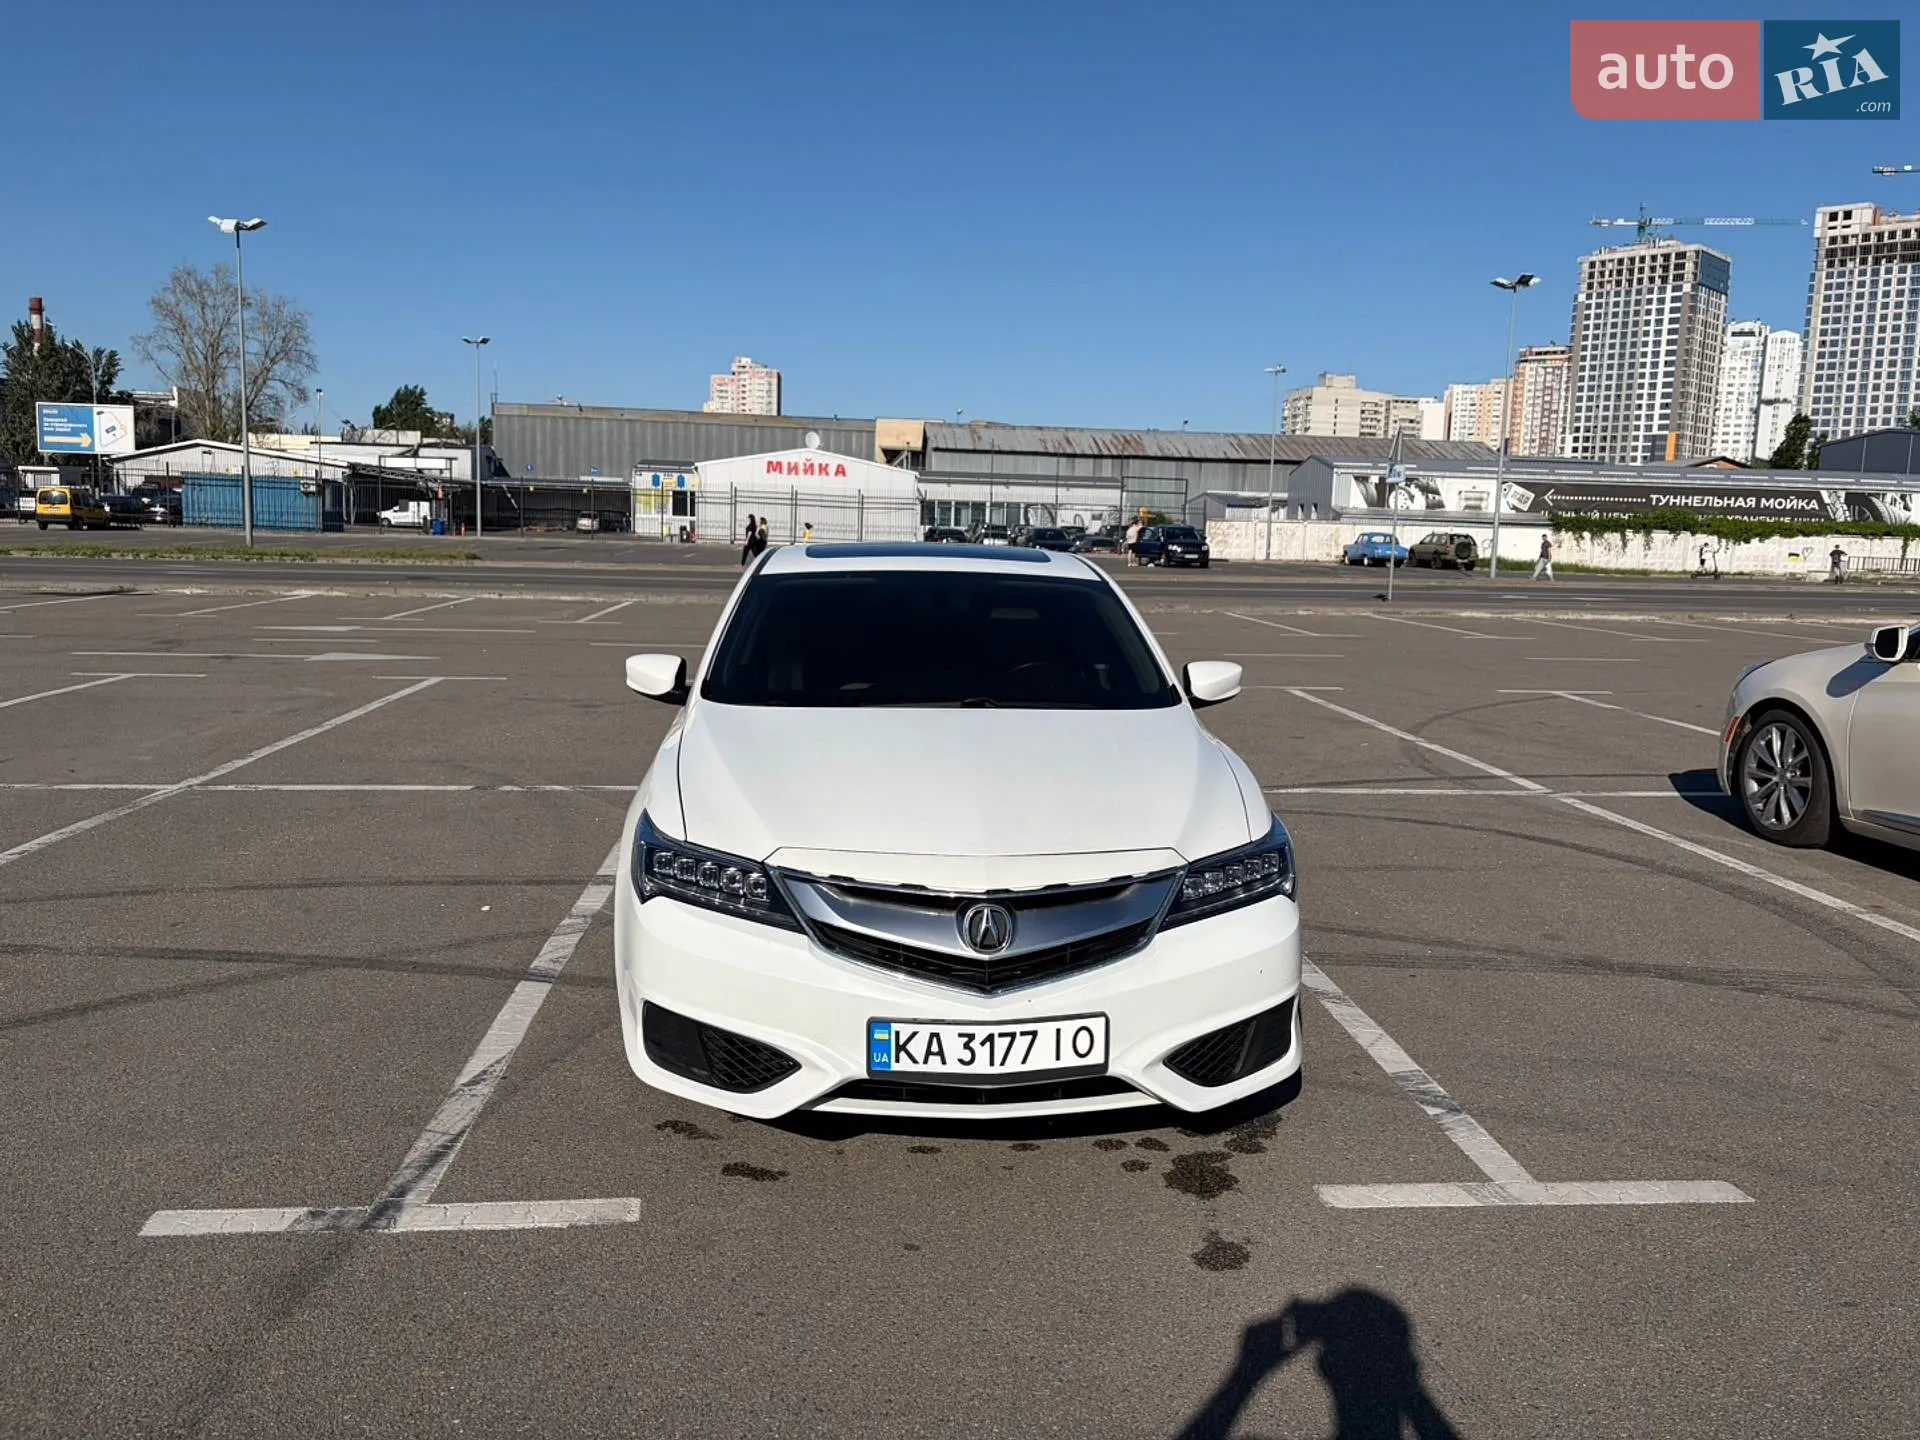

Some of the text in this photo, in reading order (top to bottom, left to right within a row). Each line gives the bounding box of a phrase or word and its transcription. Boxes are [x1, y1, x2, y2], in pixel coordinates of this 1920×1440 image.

[766, 456, 847, 477] МИЙКА
[1650, 494, 1819, 510] ТУННЕЛЬНАЯ МОЙКА
[894, 1030, 947, 1066] KA
[957, 1029, 1039, 1067] 3177
[873, 1052, 889, 1063] UA
